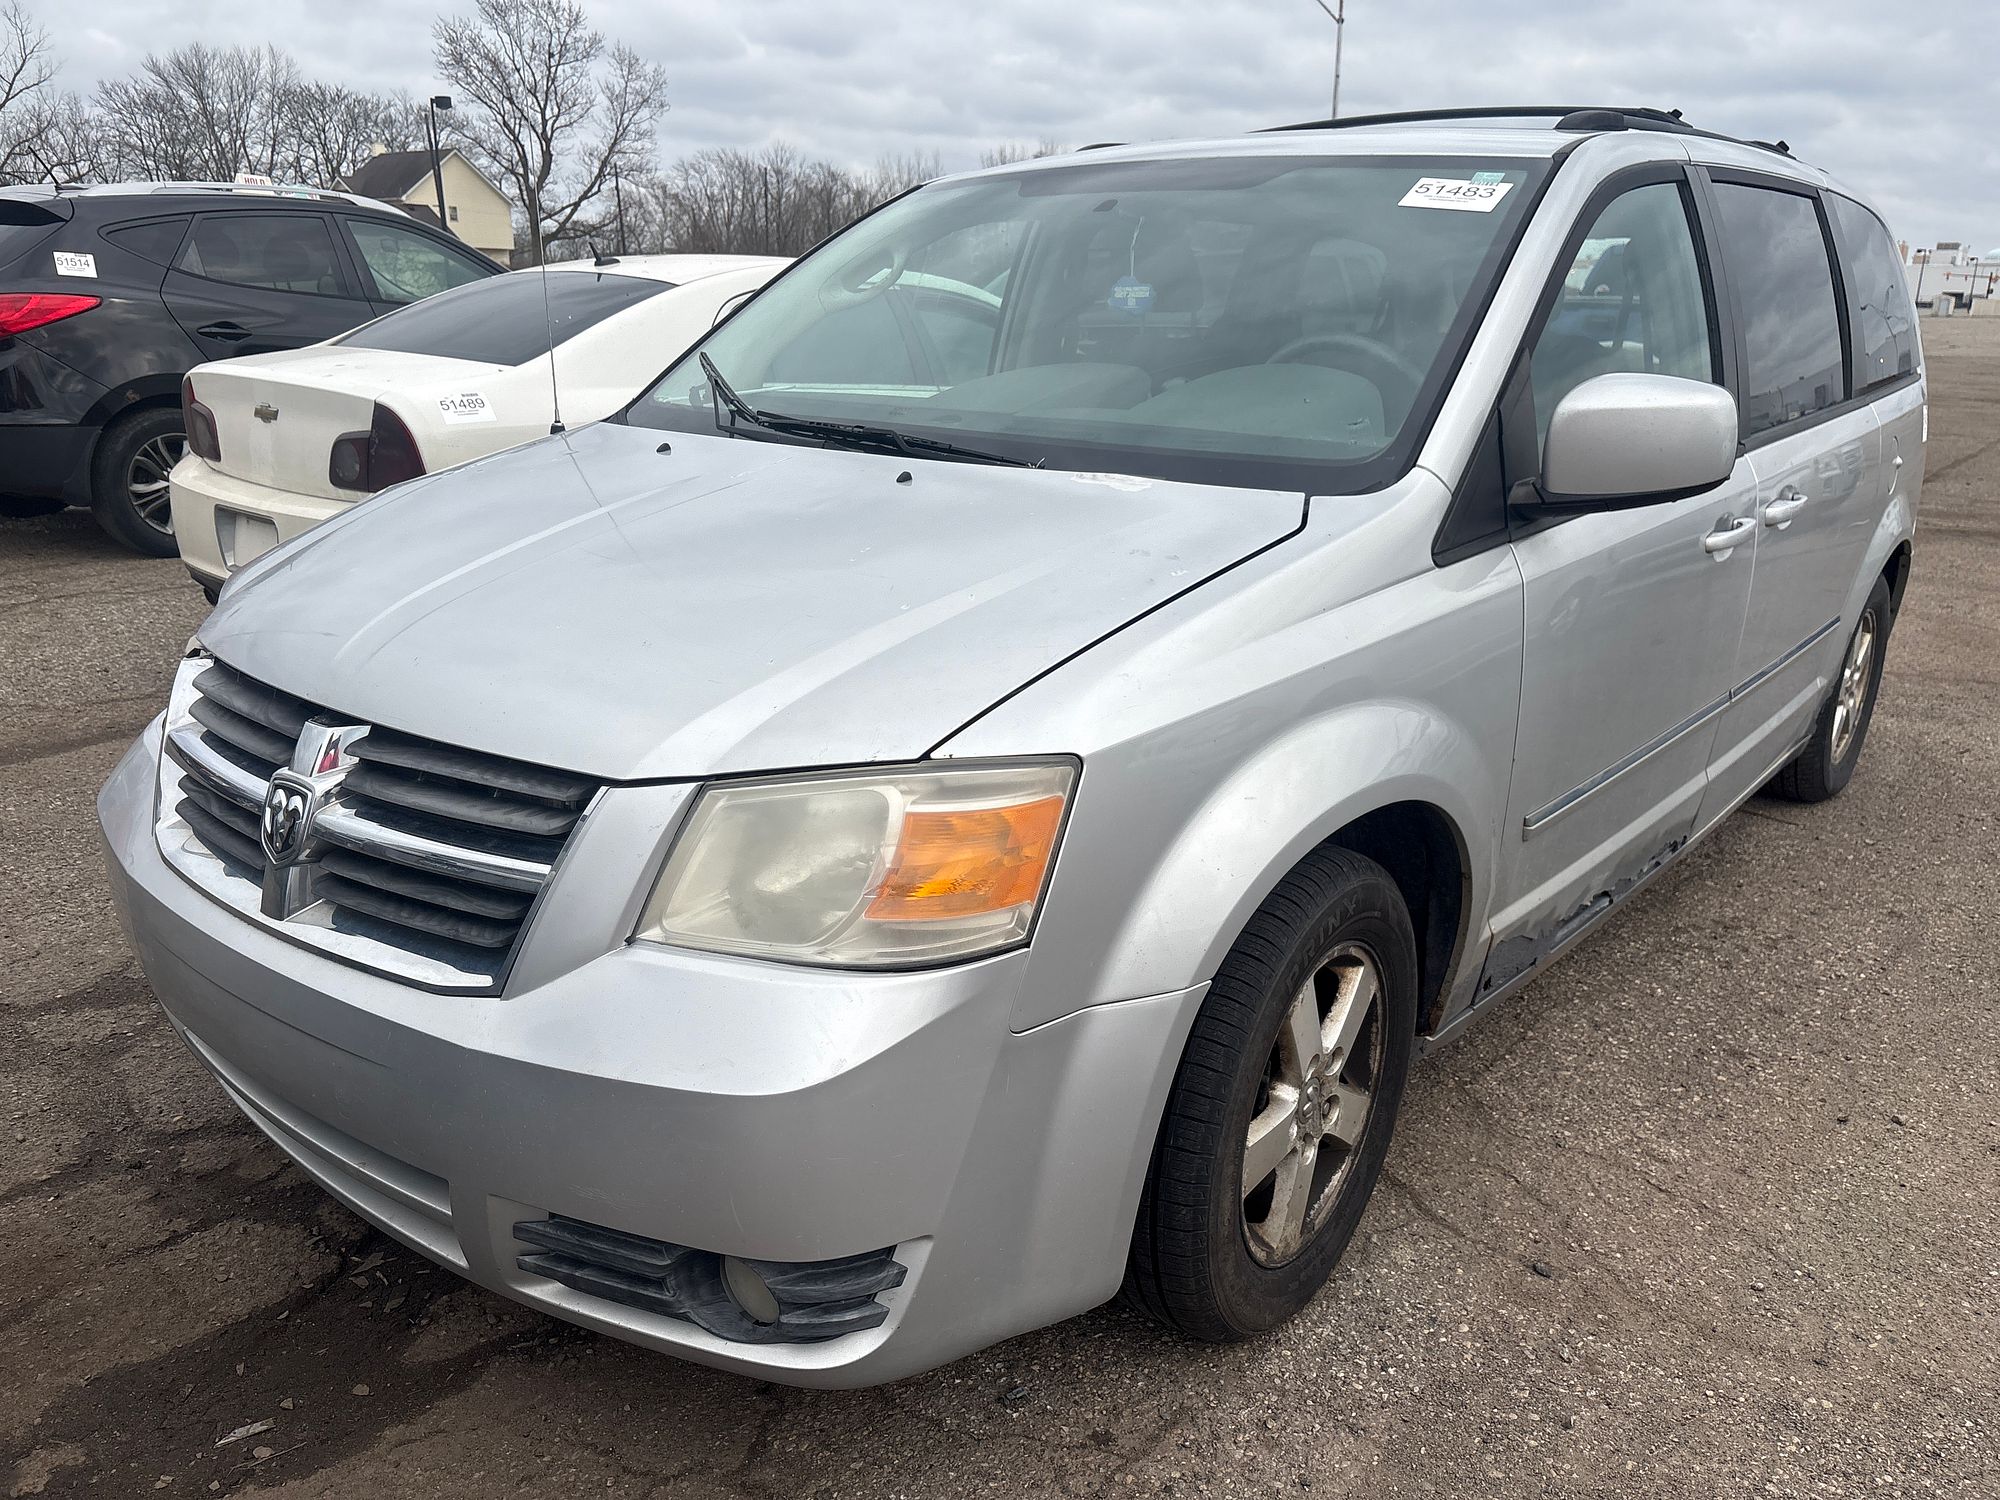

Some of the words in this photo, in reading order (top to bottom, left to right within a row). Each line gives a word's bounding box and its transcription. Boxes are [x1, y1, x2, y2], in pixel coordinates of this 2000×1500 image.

[1415, 183, 1496, 198] 51483
[56, 256, 90, 268] 51514
[439, 397, 486, 411] 51489
[1286, 894, 1358, 994] PRINX
